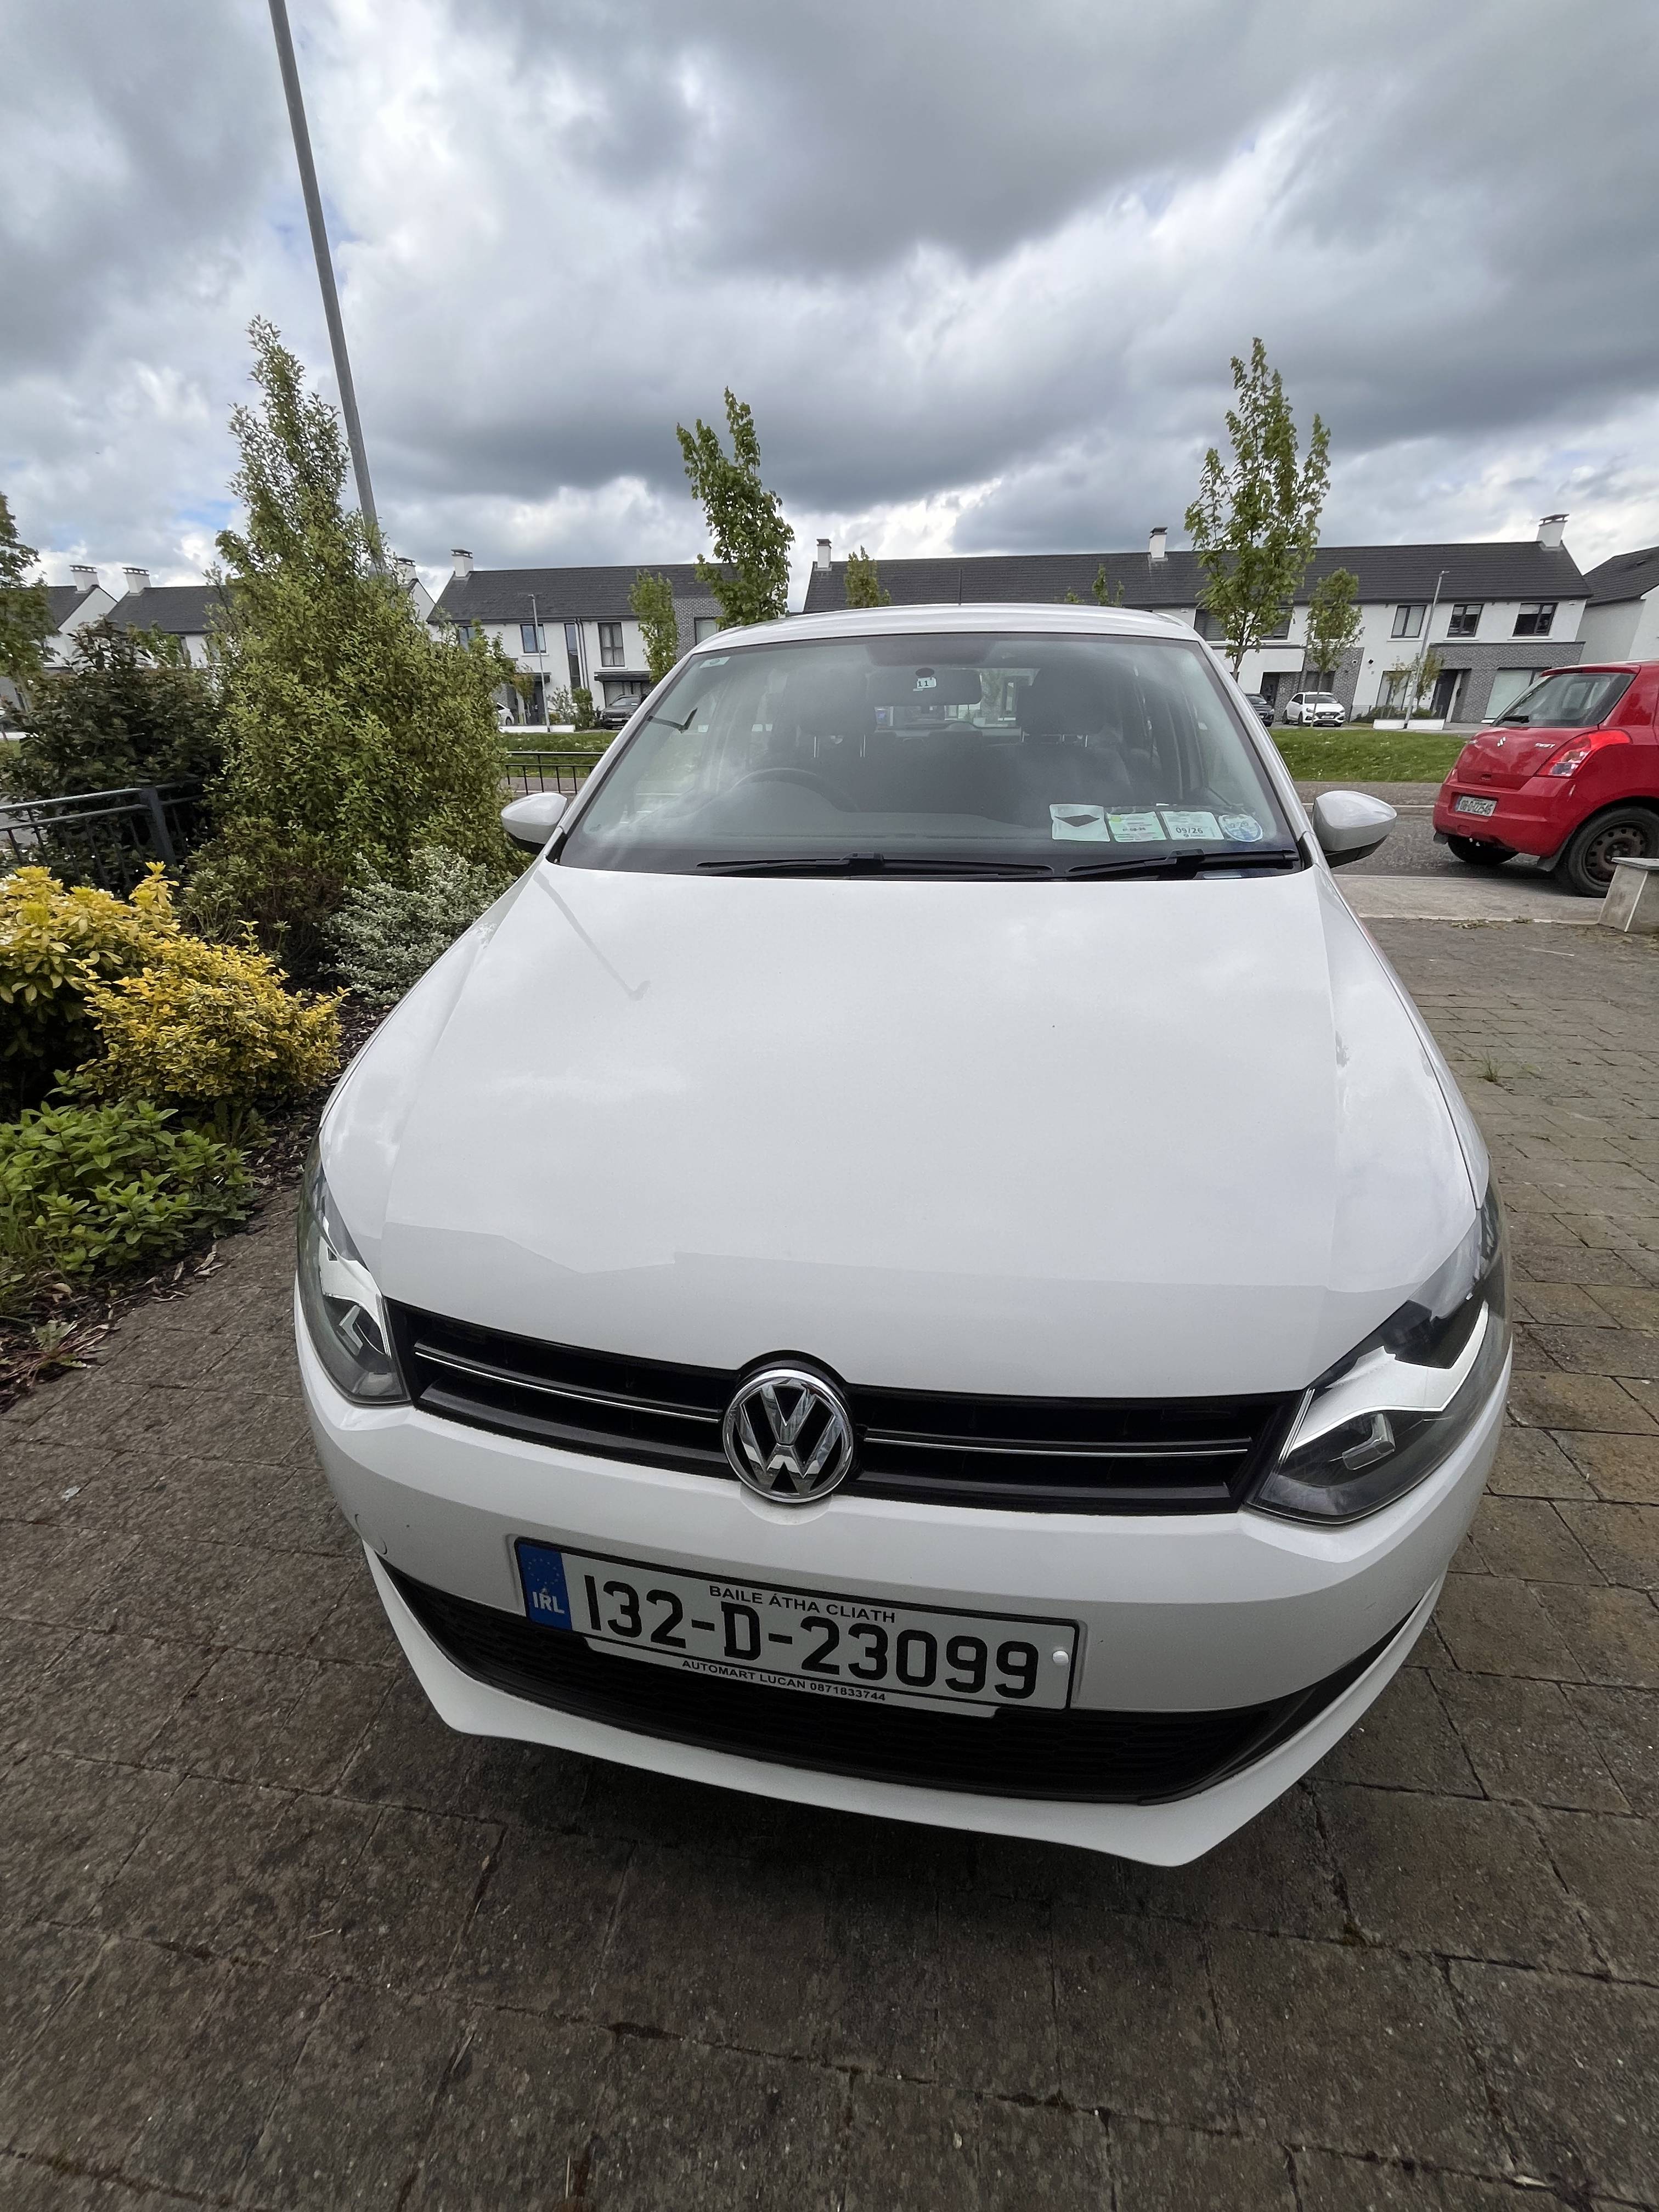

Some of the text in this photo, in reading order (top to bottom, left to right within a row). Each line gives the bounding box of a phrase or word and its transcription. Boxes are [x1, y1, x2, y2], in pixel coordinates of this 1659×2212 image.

[533, 1592, 565, 1614] IRL
[709, 1585, 895, 1623] BAILE ÁTHA CLIATH
[584, 1575, 1039, 1699] 132-D-23099
[682, 1660, 885, 1701] AUTOMART LUCAN 0871833744
